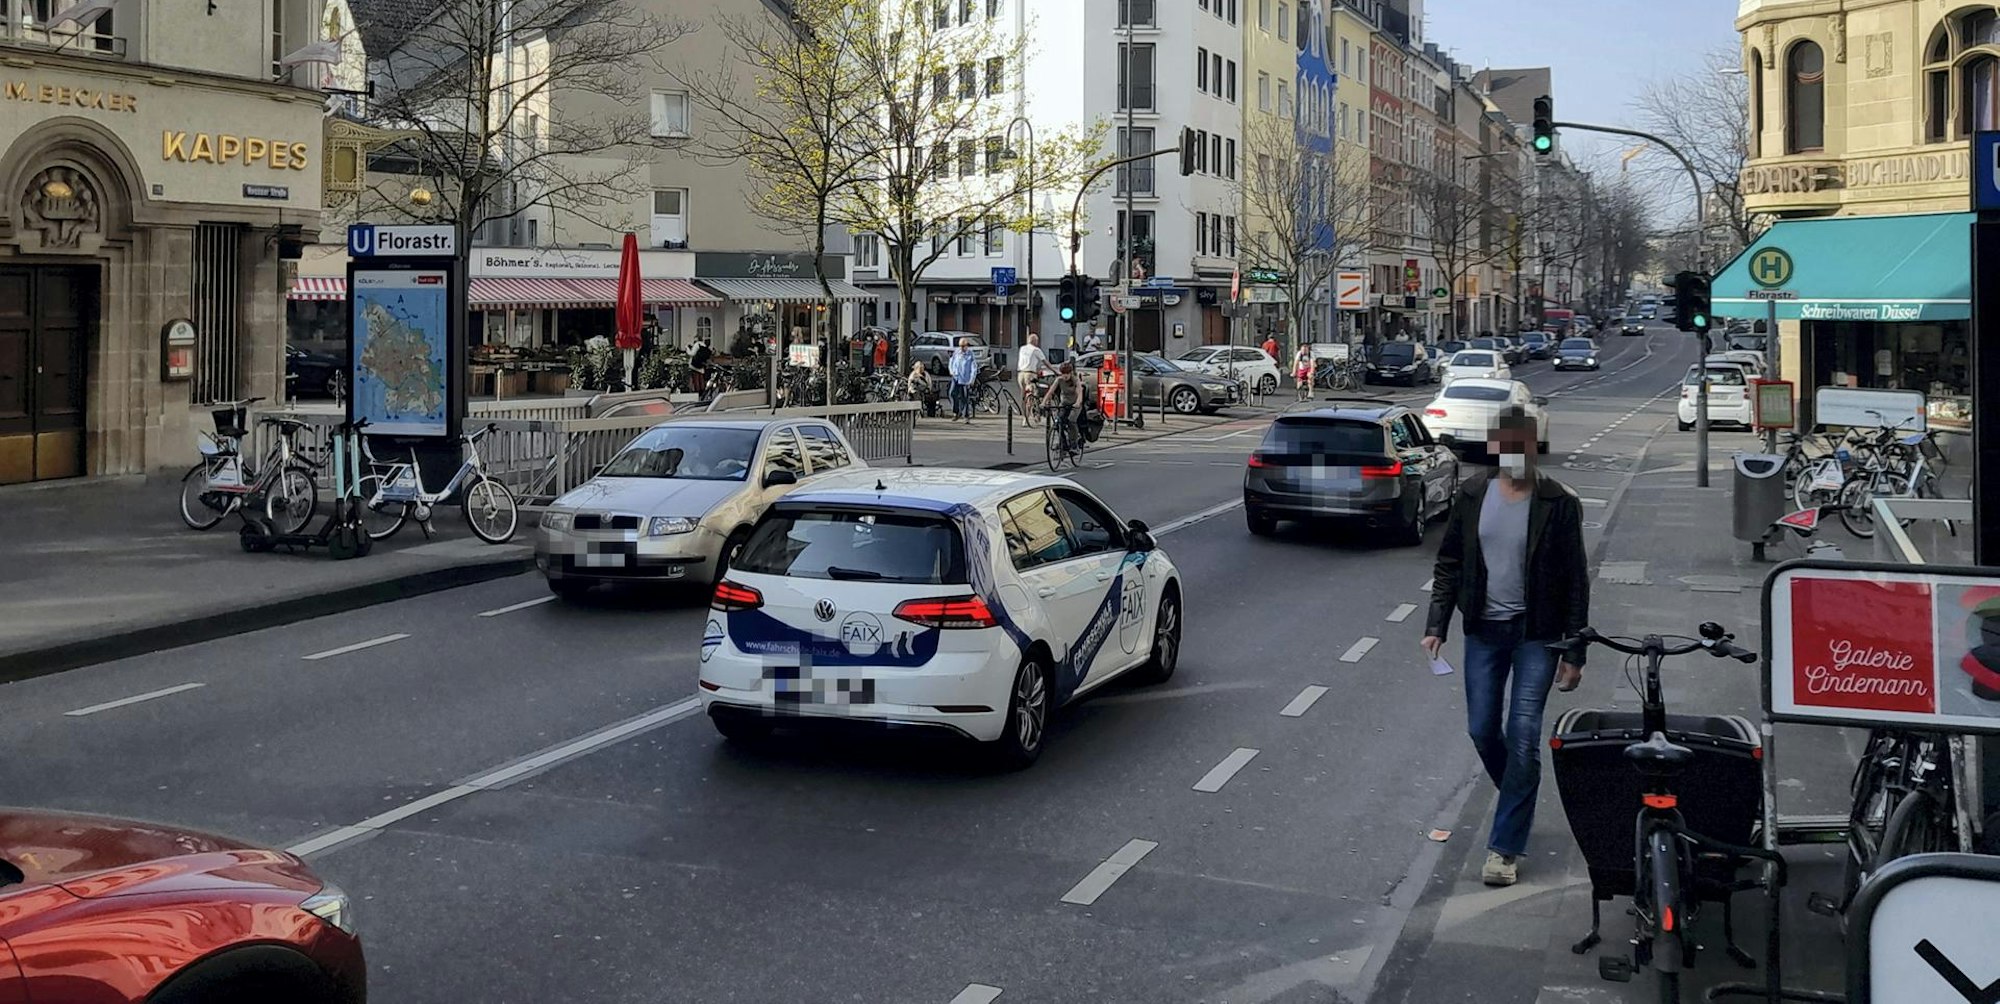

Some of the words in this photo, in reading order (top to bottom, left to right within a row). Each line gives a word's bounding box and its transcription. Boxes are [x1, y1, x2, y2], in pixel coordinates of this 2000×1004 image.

[5, 80, 33, 102] M.
[38, 85, 138, 113] BECKER
[162, 129, 309, 171] KAPPES
[353, 229, 370, 253] U
[378, 232, 452, 250] Florastr.
[1801, 303, 1878, 320] Schreibwaren
[1881, 304, 1923, 320] Düssel
[1120, 588, 1144, 625] FAIX
[843, 626, 880, 642] FAIX
[1829, 639, 1913, 671] Galerie
